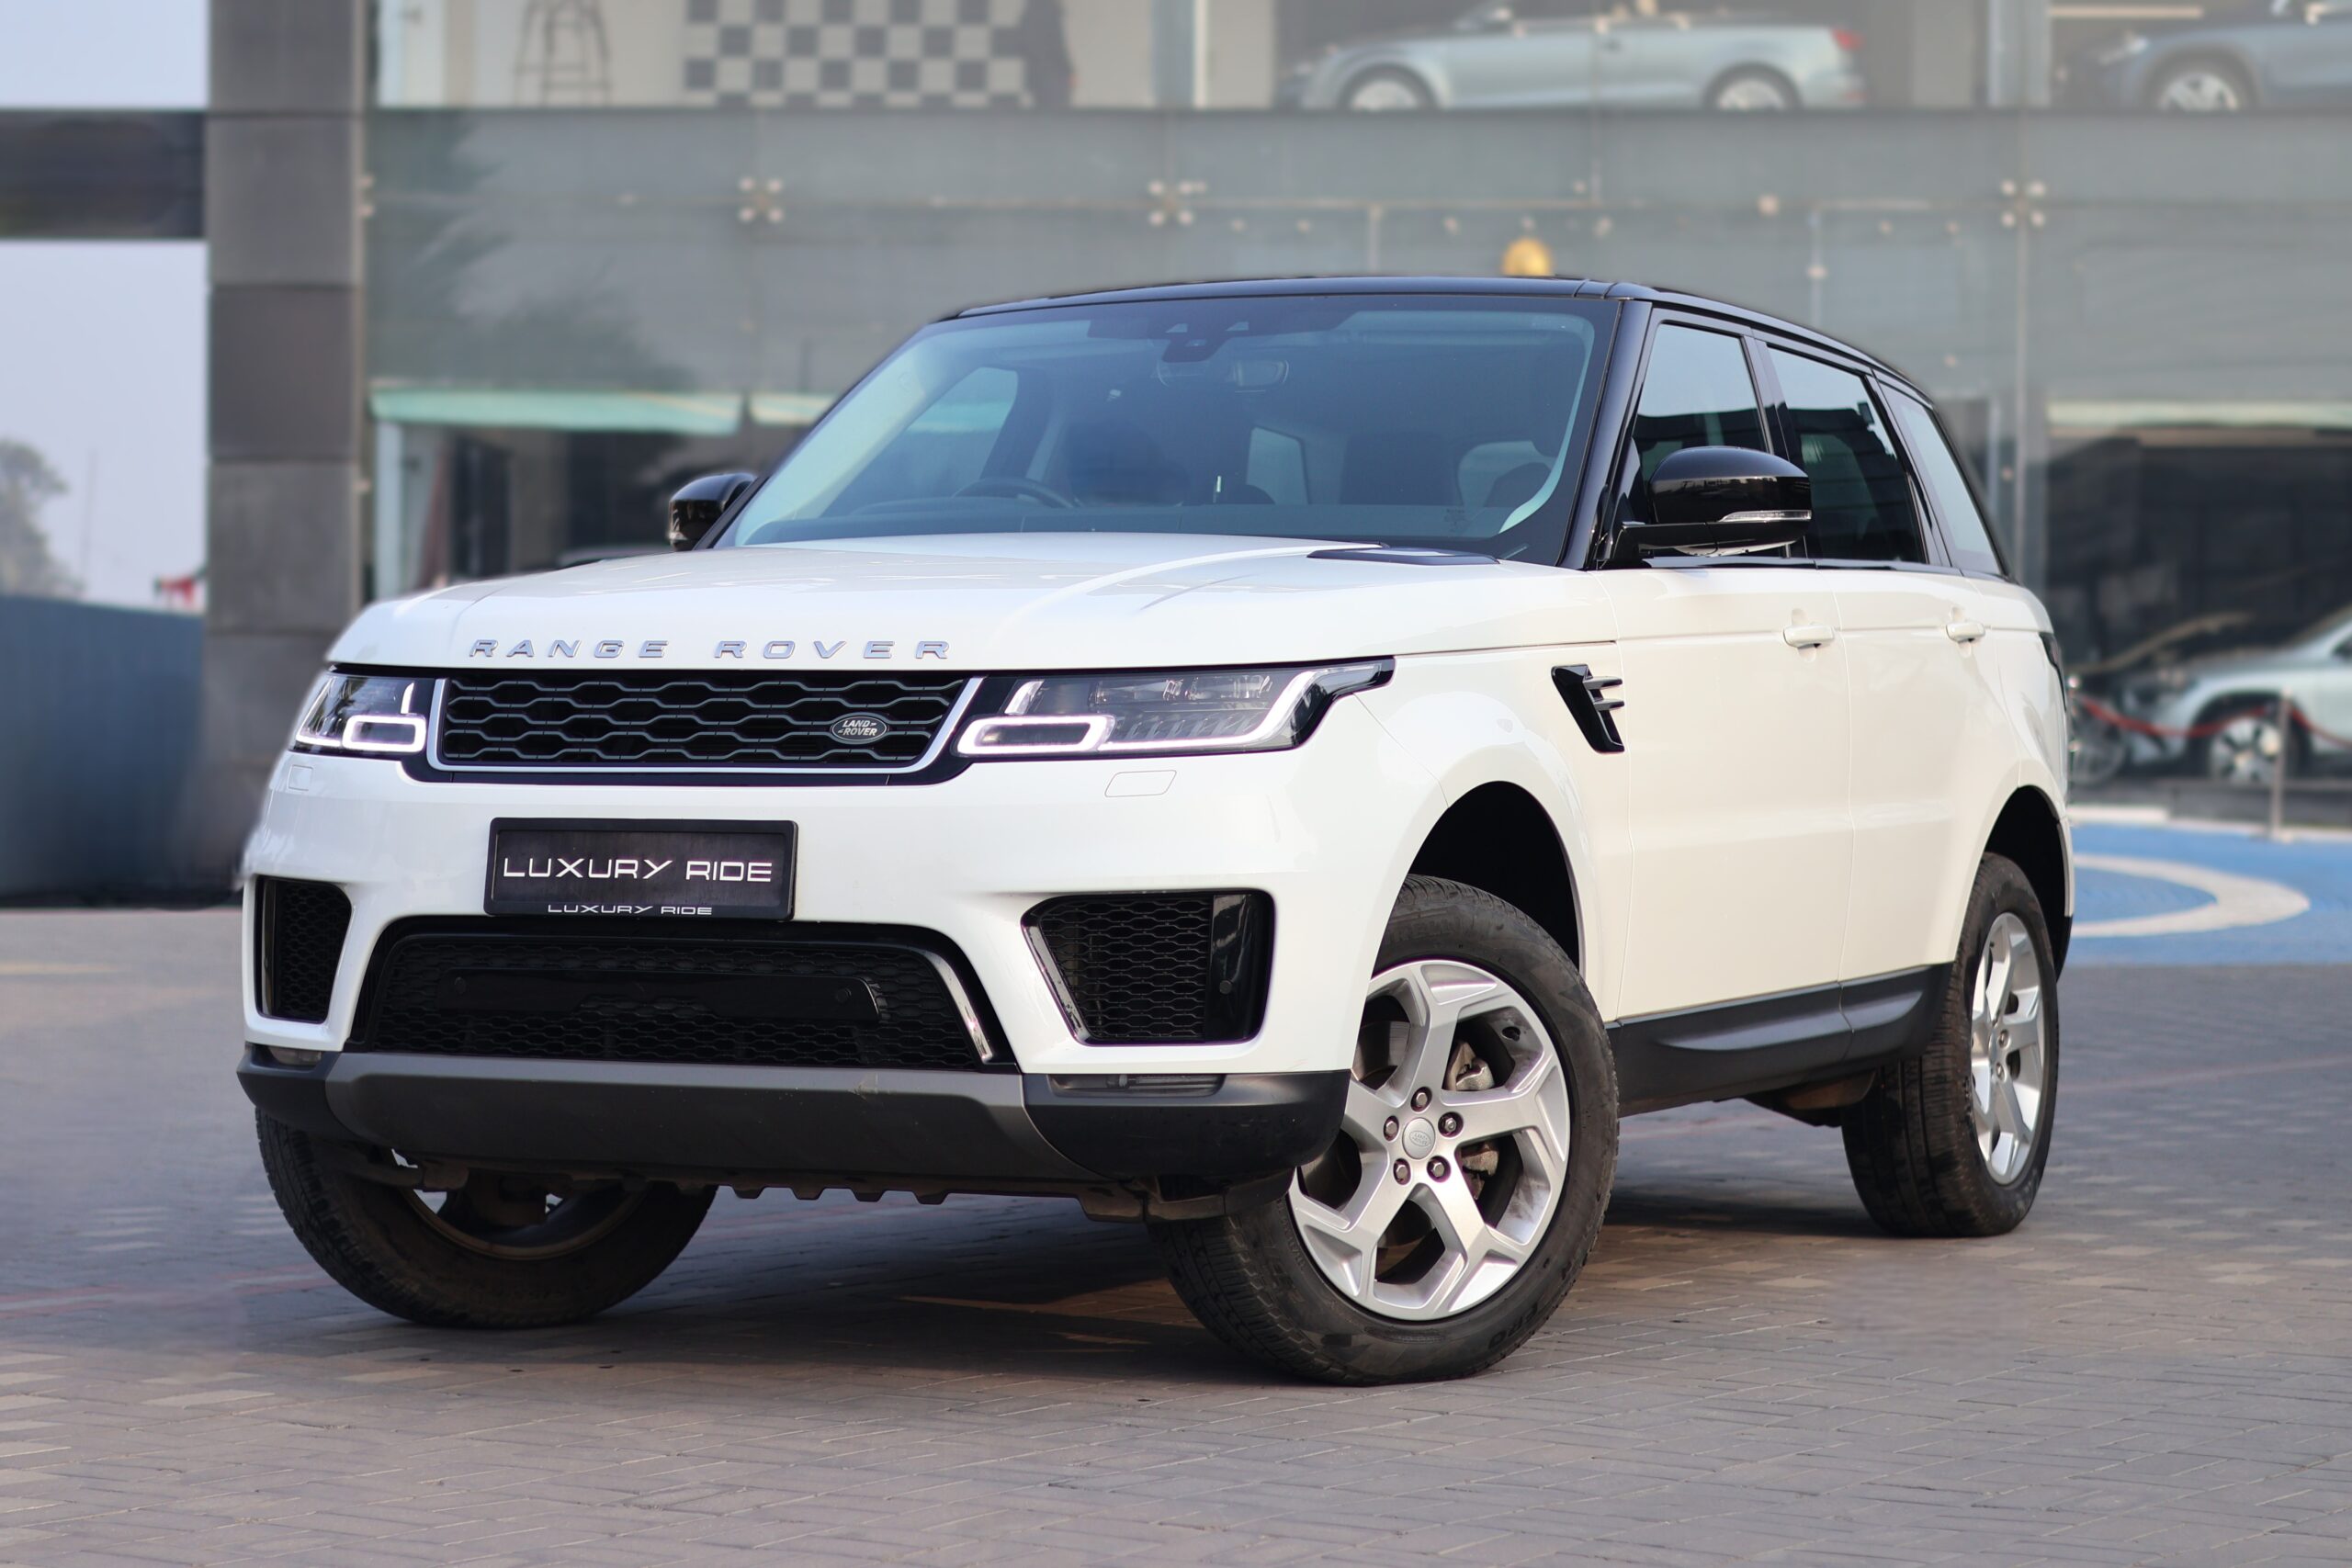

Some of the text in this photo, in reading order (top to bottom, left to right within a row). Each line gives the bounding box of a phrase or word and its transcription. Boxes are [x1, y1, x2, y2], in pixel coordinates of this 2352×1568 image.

[469, 639, 950, 660] RANGE ROVER
[842, 728, 877, 736] ROVER
[503, 857, 773, 882] LUXURY RIDE
[548, 904, 712, 916] LUXURY RIDE
